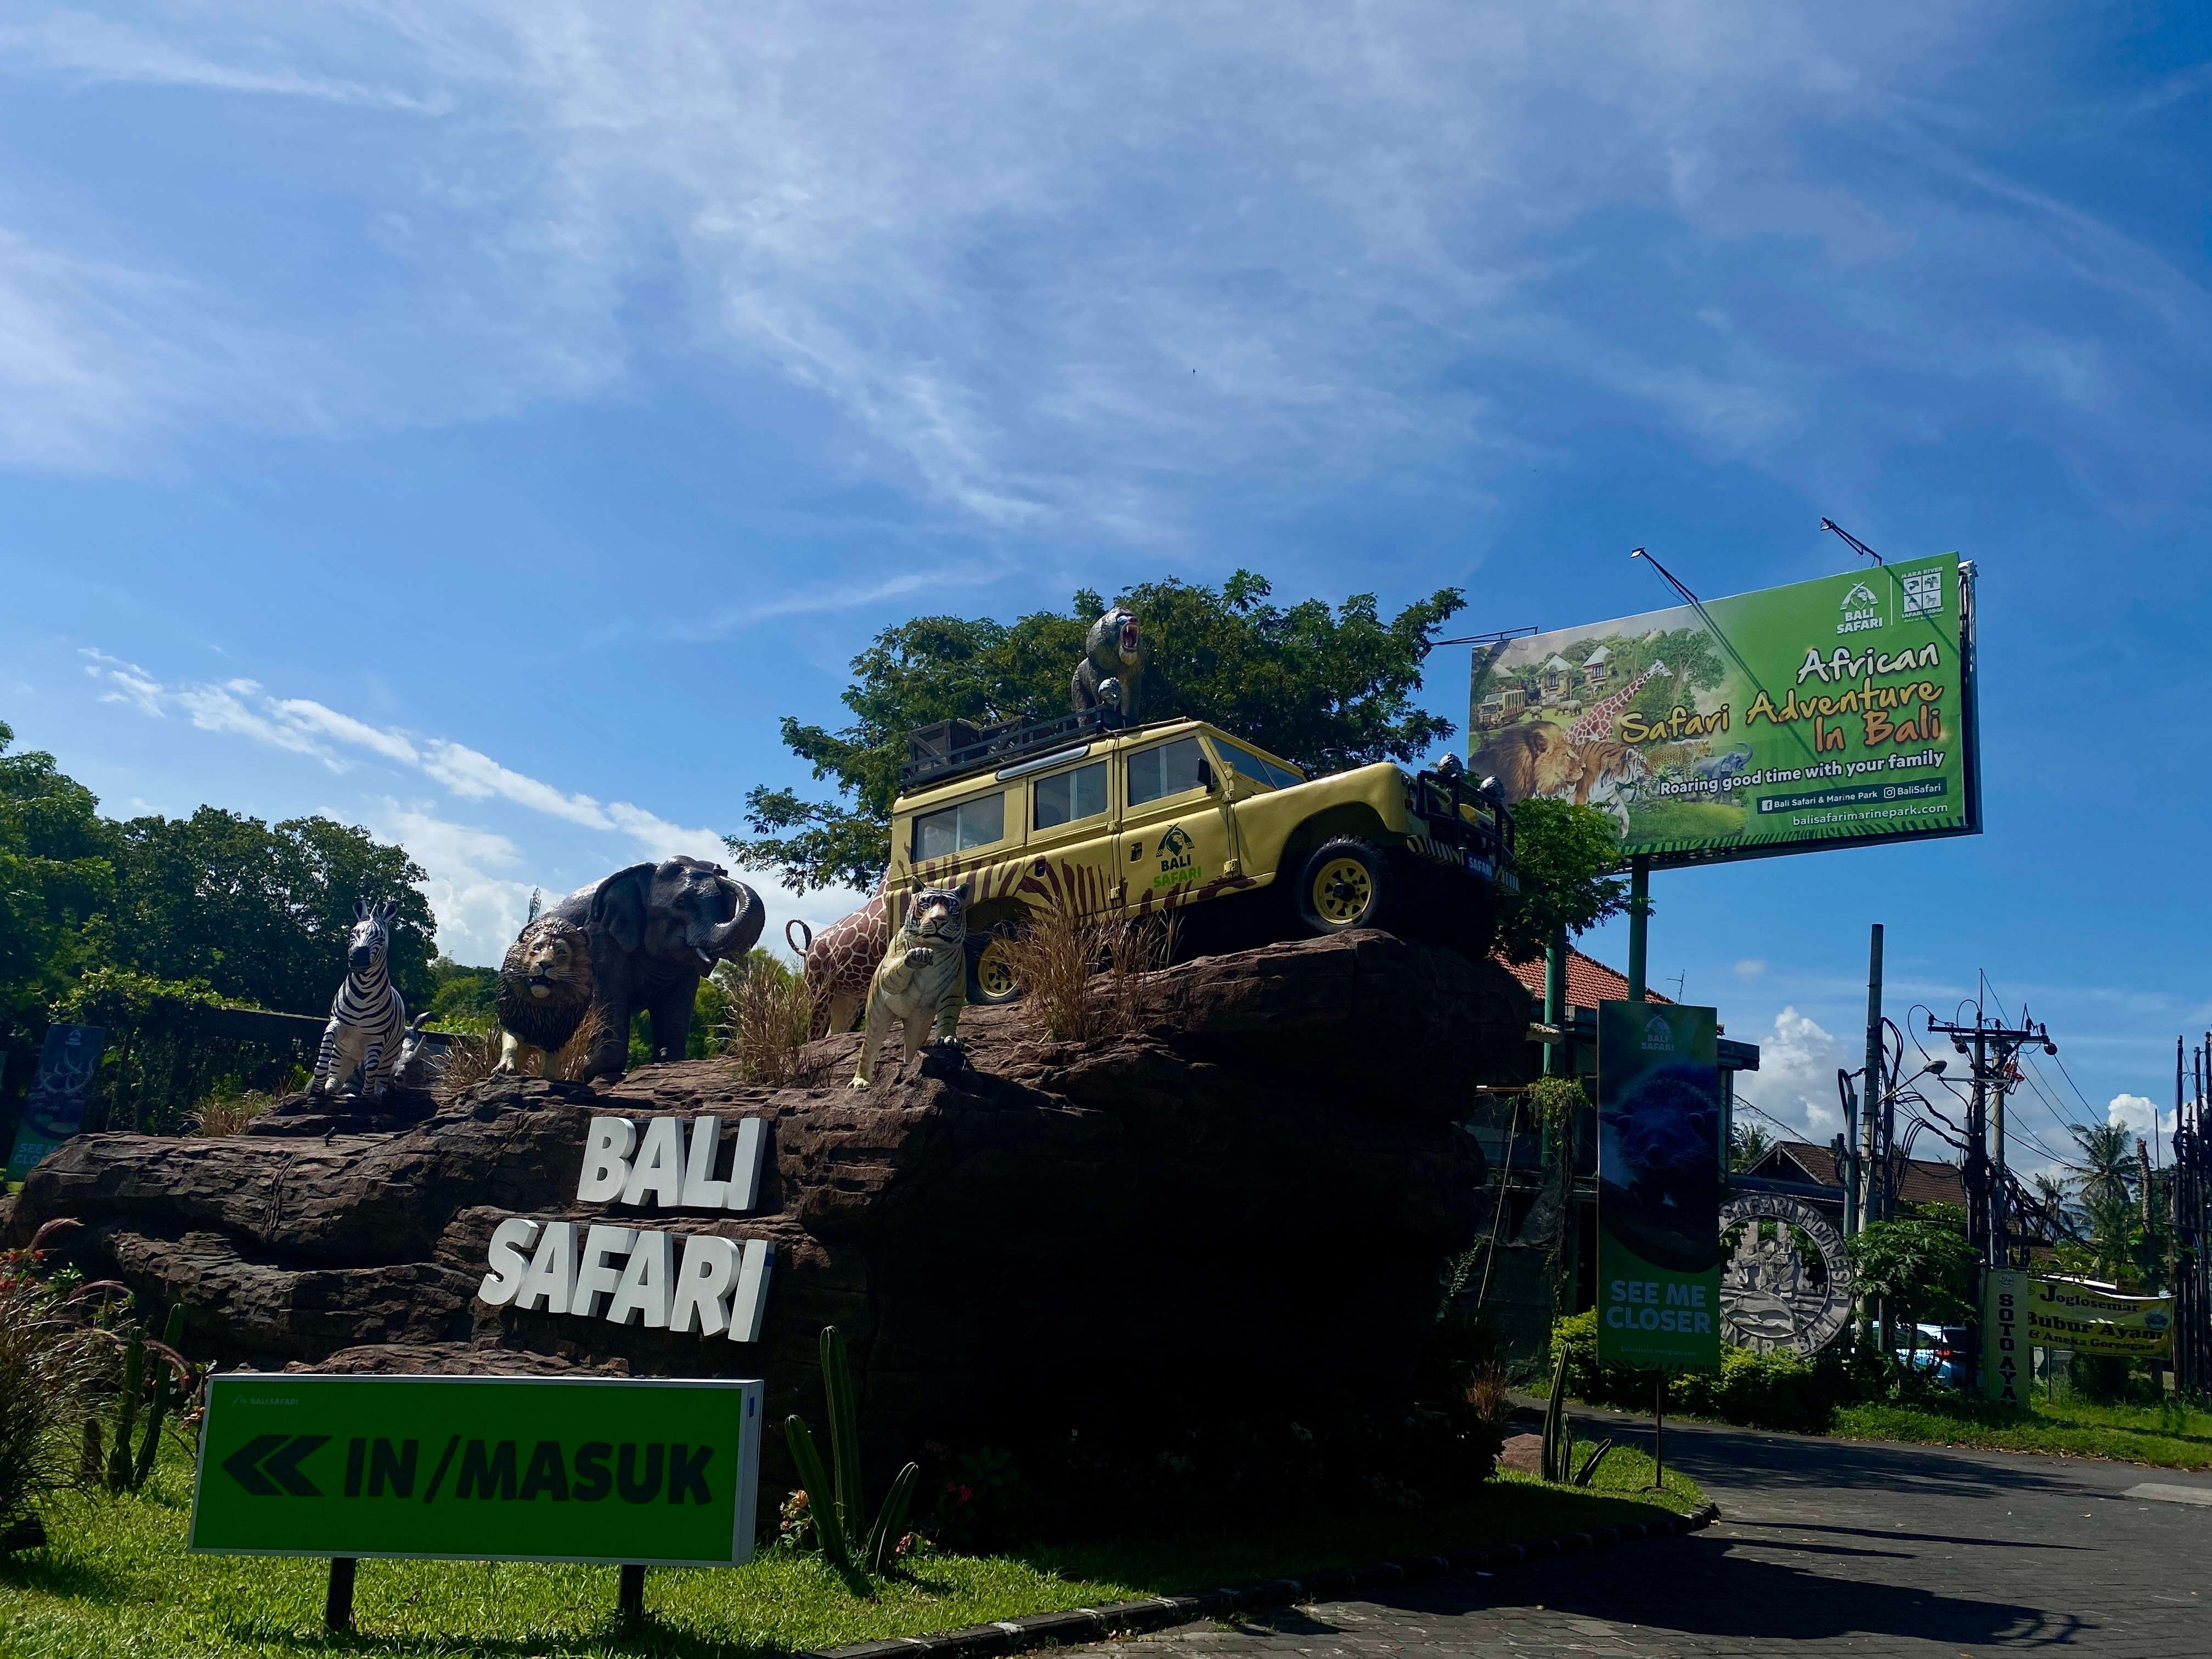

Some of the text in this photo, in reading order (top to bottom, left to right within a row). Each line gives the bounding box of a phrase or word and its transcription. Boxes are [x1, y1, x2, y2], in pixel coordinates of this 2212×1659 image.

[1923, 566, 1944, 575] RIVER
[1837, 617, 1883, 634] SAFARI
[1845, 607, 1874, 622] BALI
[1797, 642, 1939, 684] African
[1621, 678, 1943, 743] Safari Adventure
[1815, 704, 1940, 752] In Bali
[1661, 749, 1944, 795] Roaring good time with your family
[1774, 799, 1790, 808] Bali
[1792, 797, 1816, 806] Safari
[1827, 793, 1855, 803] Marine
[1858, 791, 1877, 799] Park
[1898, 783, 1940, 795] BaliSafari
[1793, 804, 1948, 826] balisafarimarinepark.com
[1161, 854, 1191, 872] BALI
[1469, 856, 1492, 878] SAFARI
[1153, 866, 1202, 888] SAFARI
[1641, 1042, 1674, 1052] SAFARI
[14, 1154, 40, 1165] CLO
[18, 1143, 58, 1154] SEE M
[577, 1115, 768, 1210] BALI
[1721, 1194, 1851, 1300] SAFARI INDONESIA
[478, 1218, 775, 1342] SAFARI
[1611, 1280, 1707, 1307] SEE ME
[2040, 1284, 2141, 1312] Joglosemar
[1606, 1306, 1712, 1334] CLOSER
[1792, 1311, 1841, 1354] BALI
[1999, 1294, 2016, 1351] SOTO
[2027, 1311, 2163, 1339] Bubur Ayam
[2028, 1329, 2154, 1350] & Aneka Gorengan
[1999, 1356, 2017, 1404] AYA
